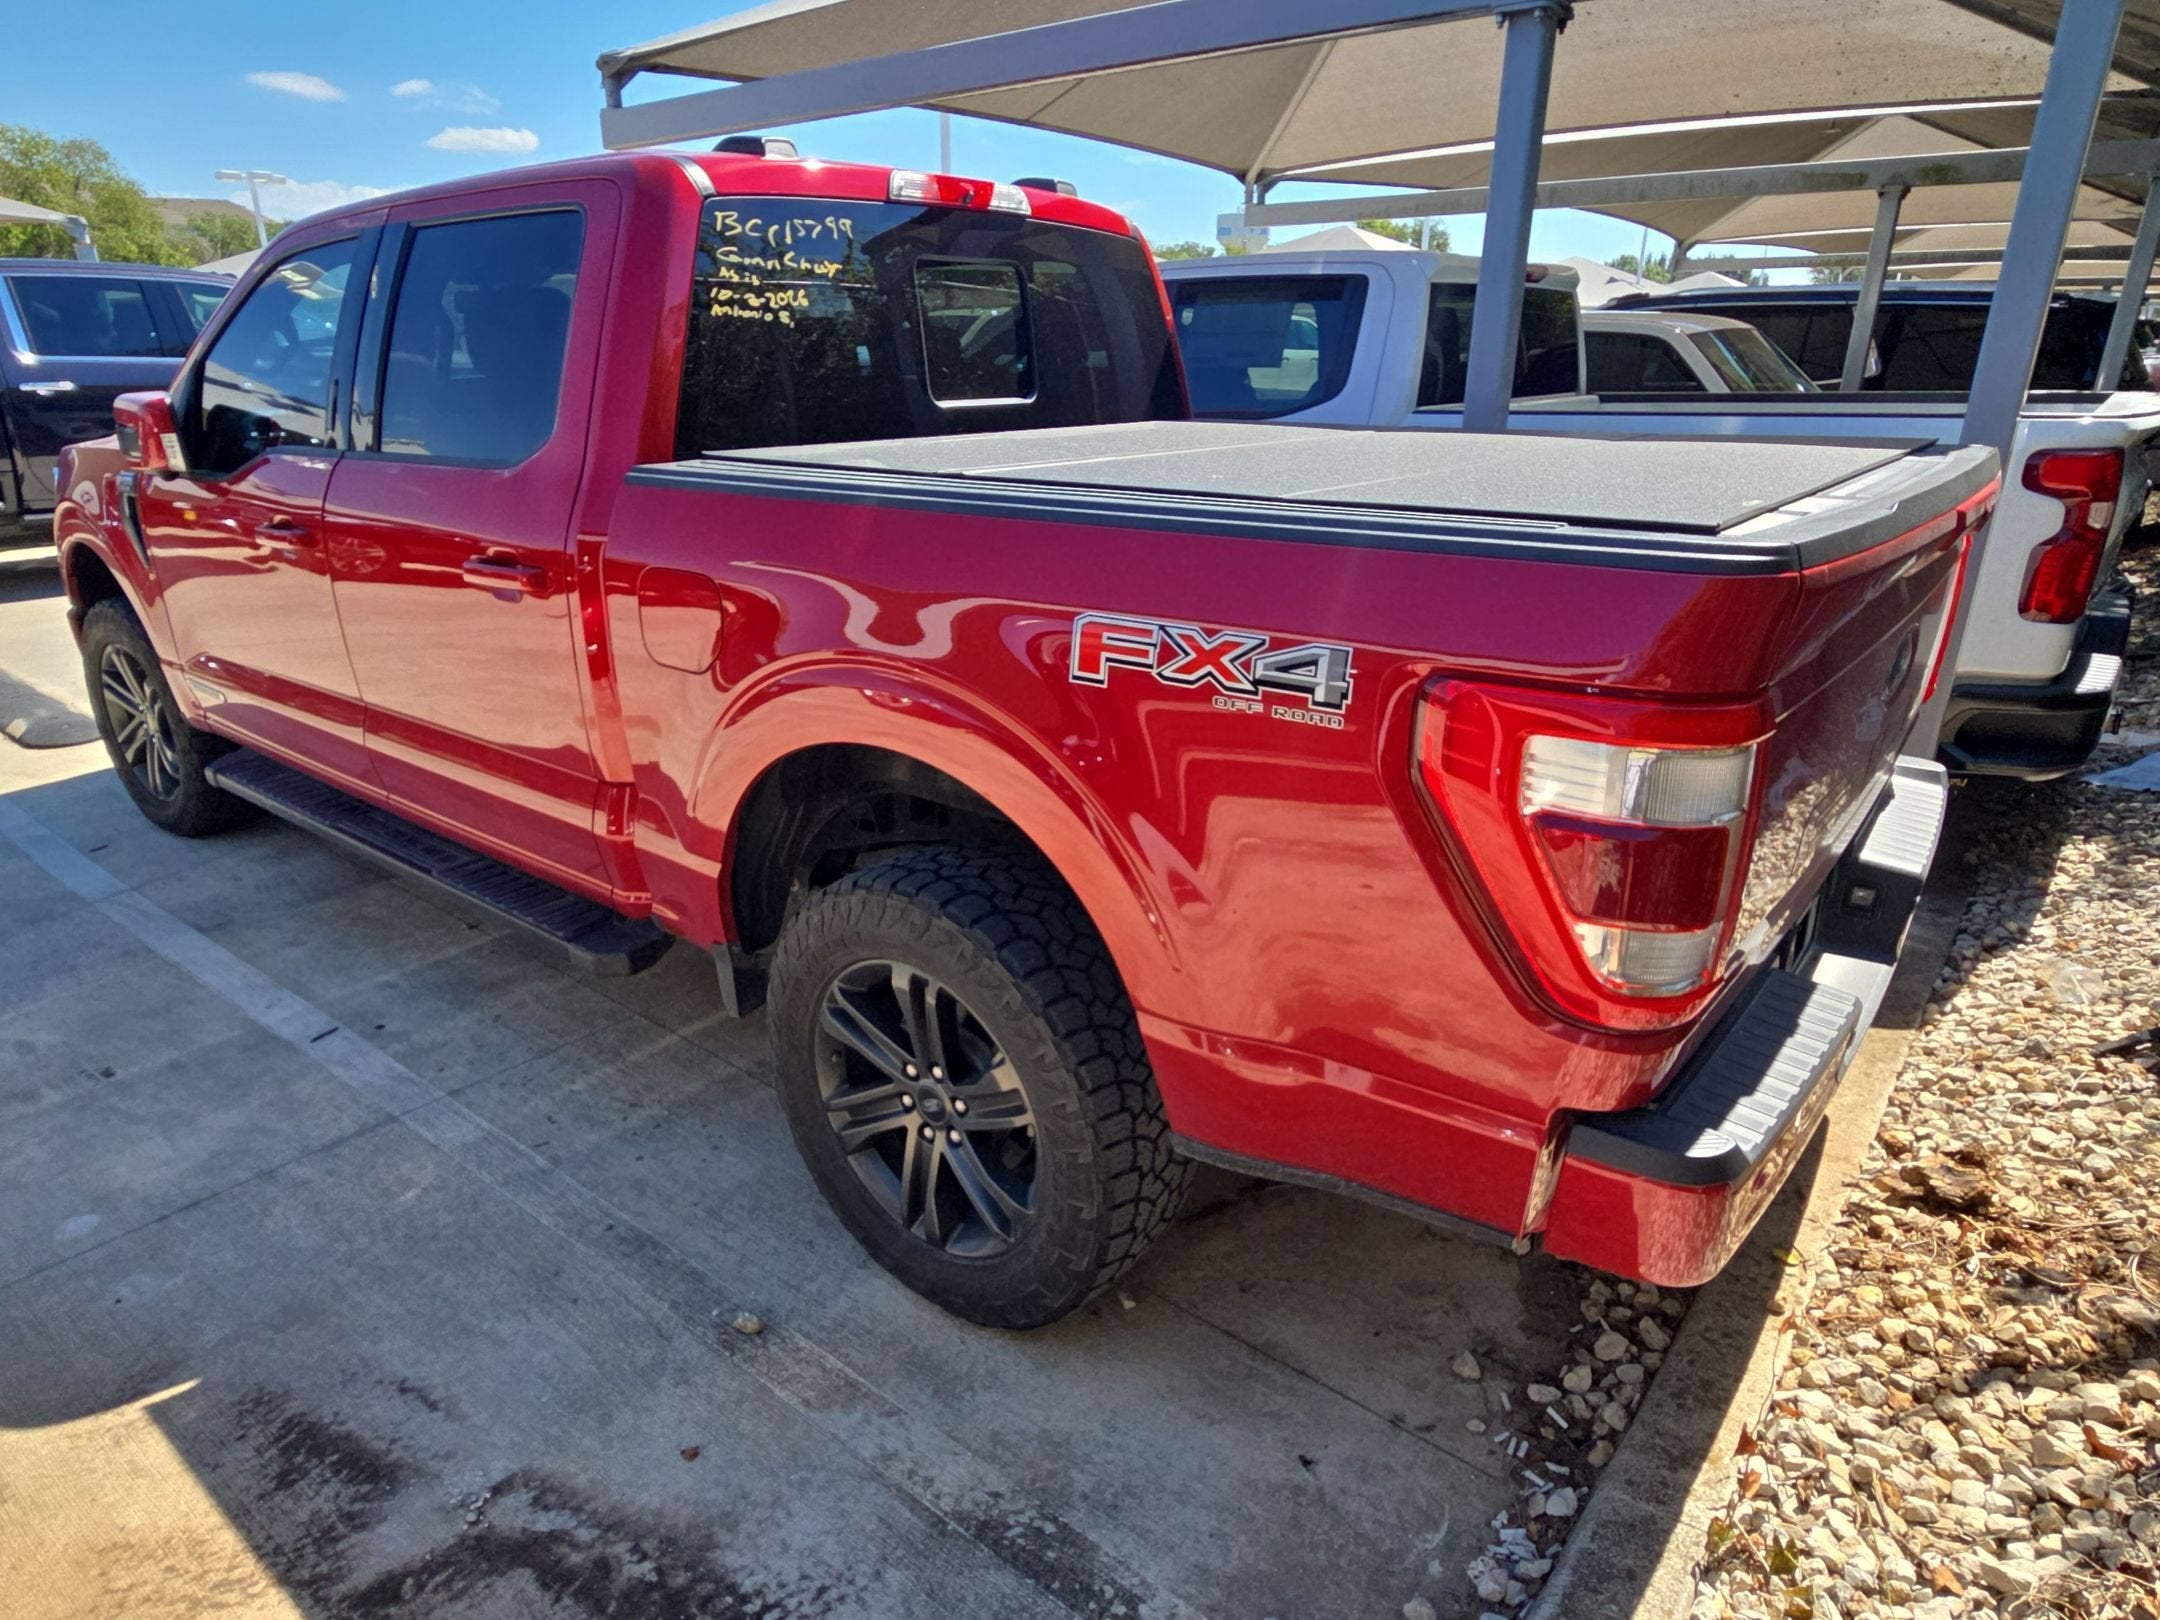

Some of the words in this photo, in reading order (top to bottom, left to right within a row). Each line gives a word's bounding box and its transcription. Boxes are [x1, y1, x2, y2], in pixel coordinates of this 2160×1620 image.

[1069, 612, 1353, 712] FX4
[1212, 696, 1264, 714] OFF
[1272, 705, 1344, 729] ROAD
